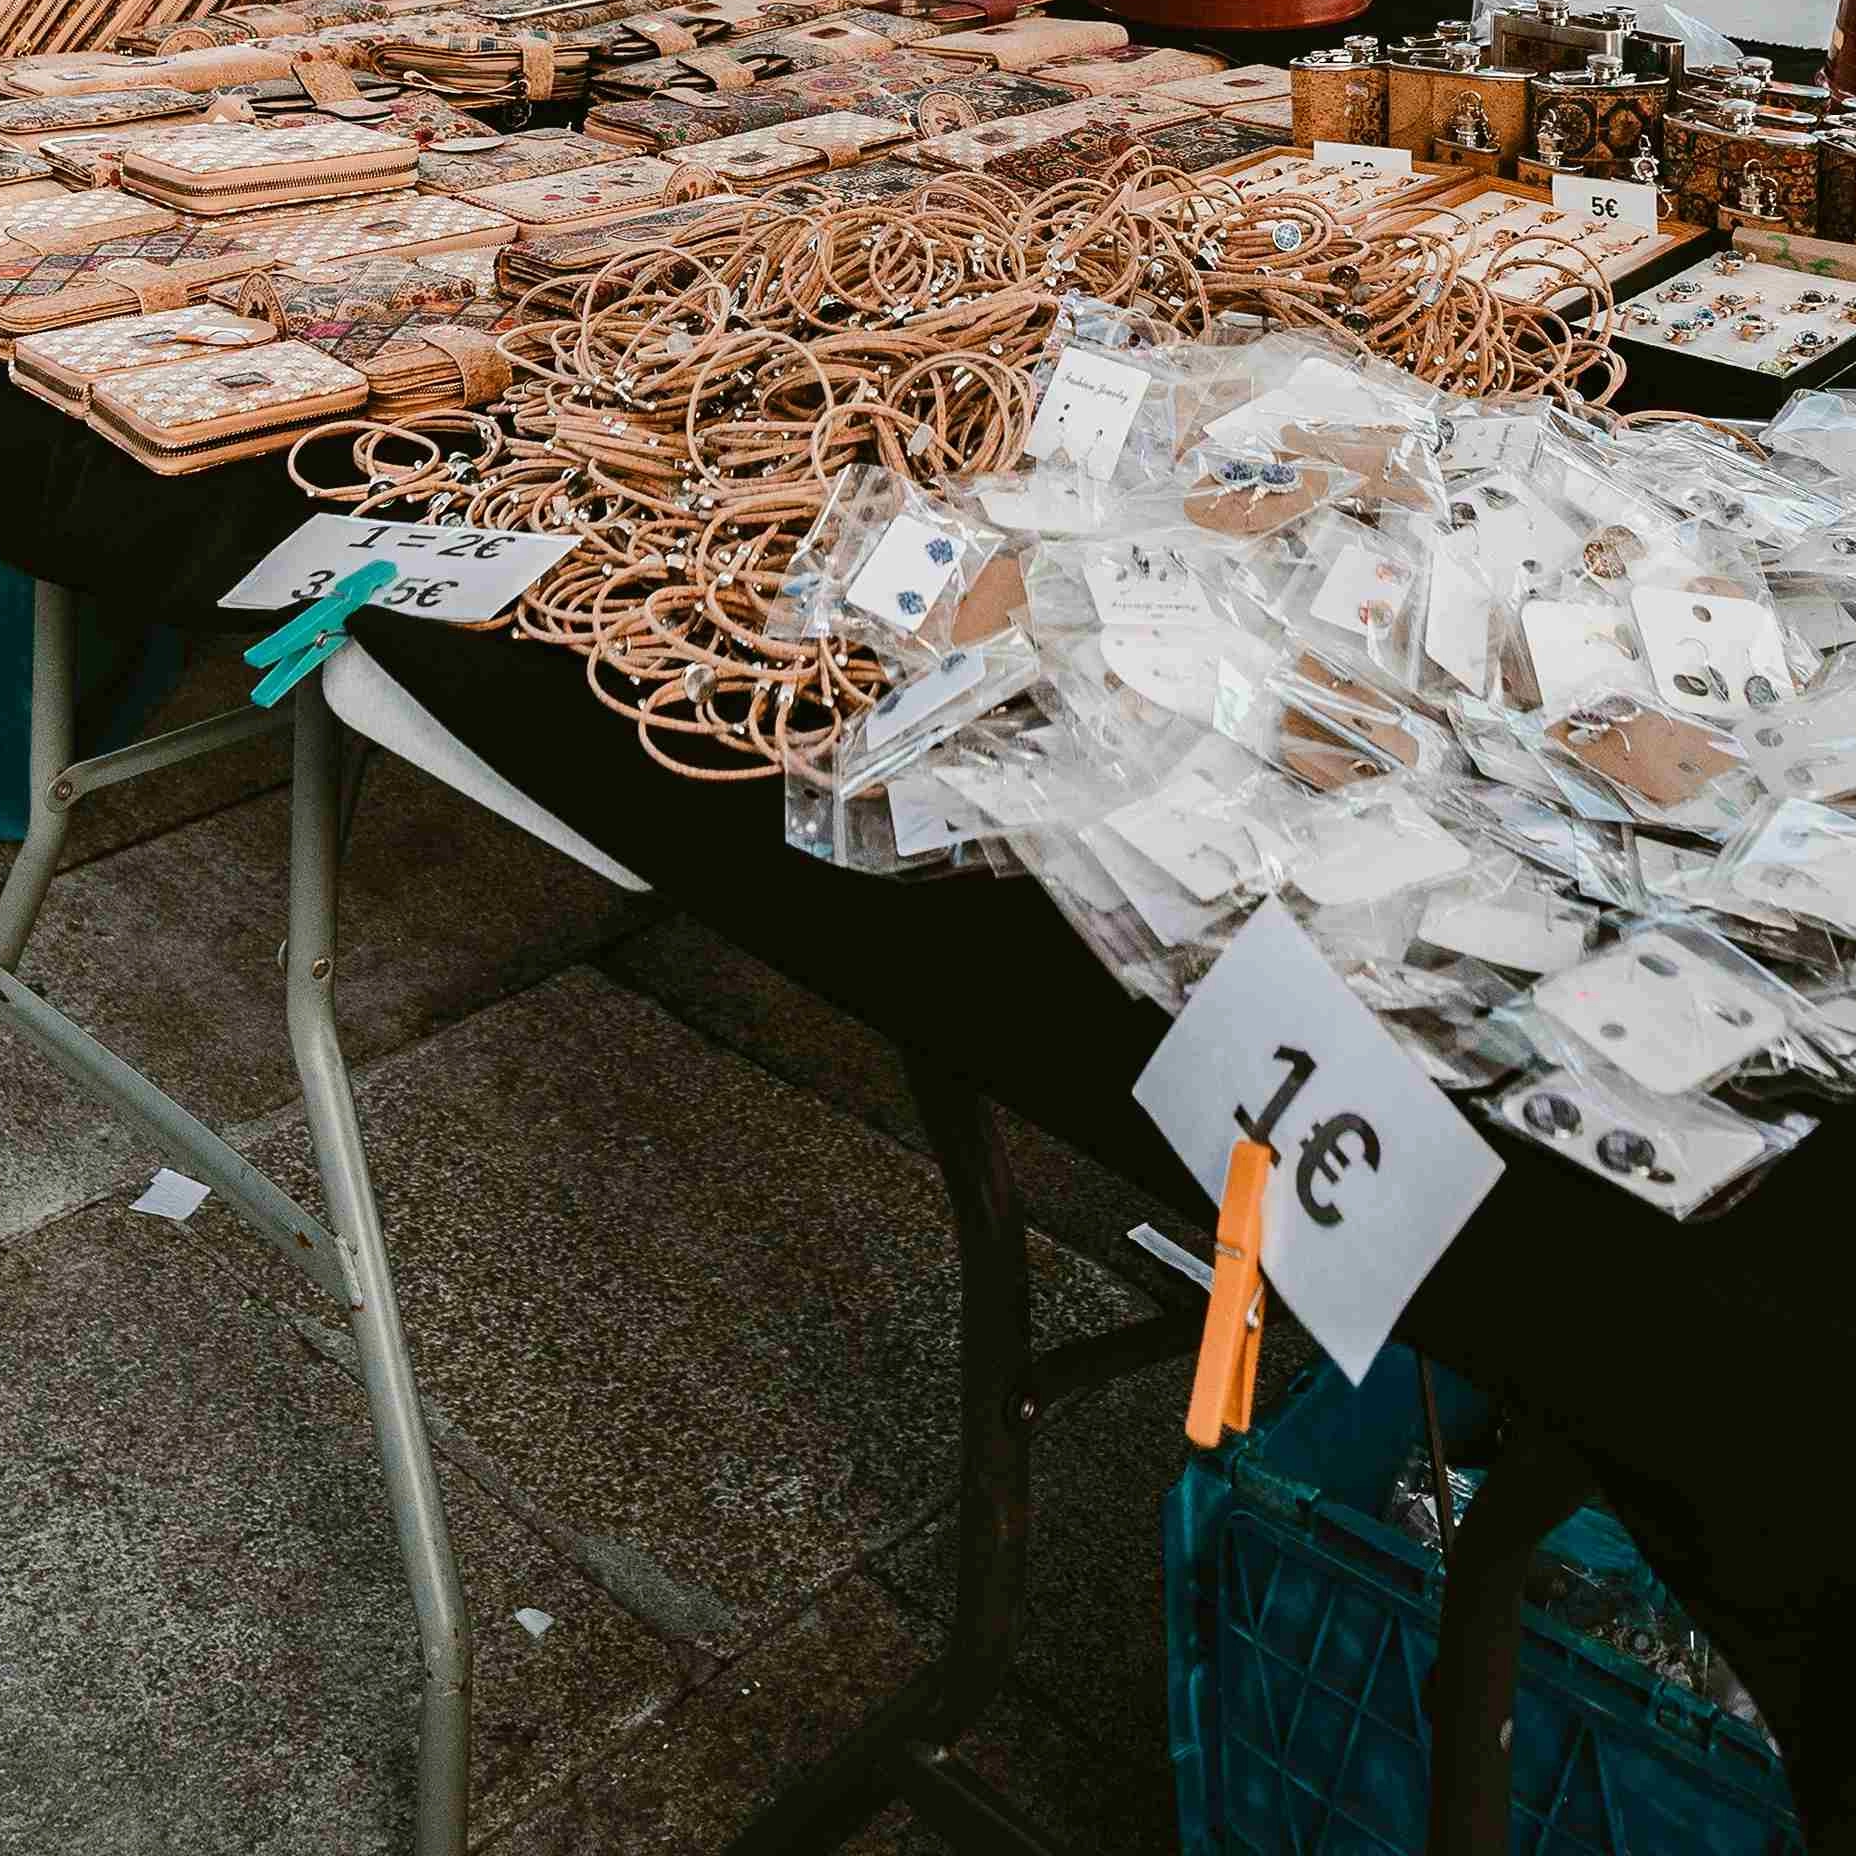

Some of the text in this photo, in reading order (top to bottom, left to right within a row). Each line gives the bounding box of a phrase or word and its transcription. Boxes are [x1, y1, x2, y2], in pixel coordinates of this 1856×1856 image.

[1591, 195, 1620, 219] 5€
[347, 525, 391, 549] 1
[437, 533, 516, 559] 2€
[291, 569, 459, 608] 3 5€
[1233, 1044, 1382, 1230] 1€
